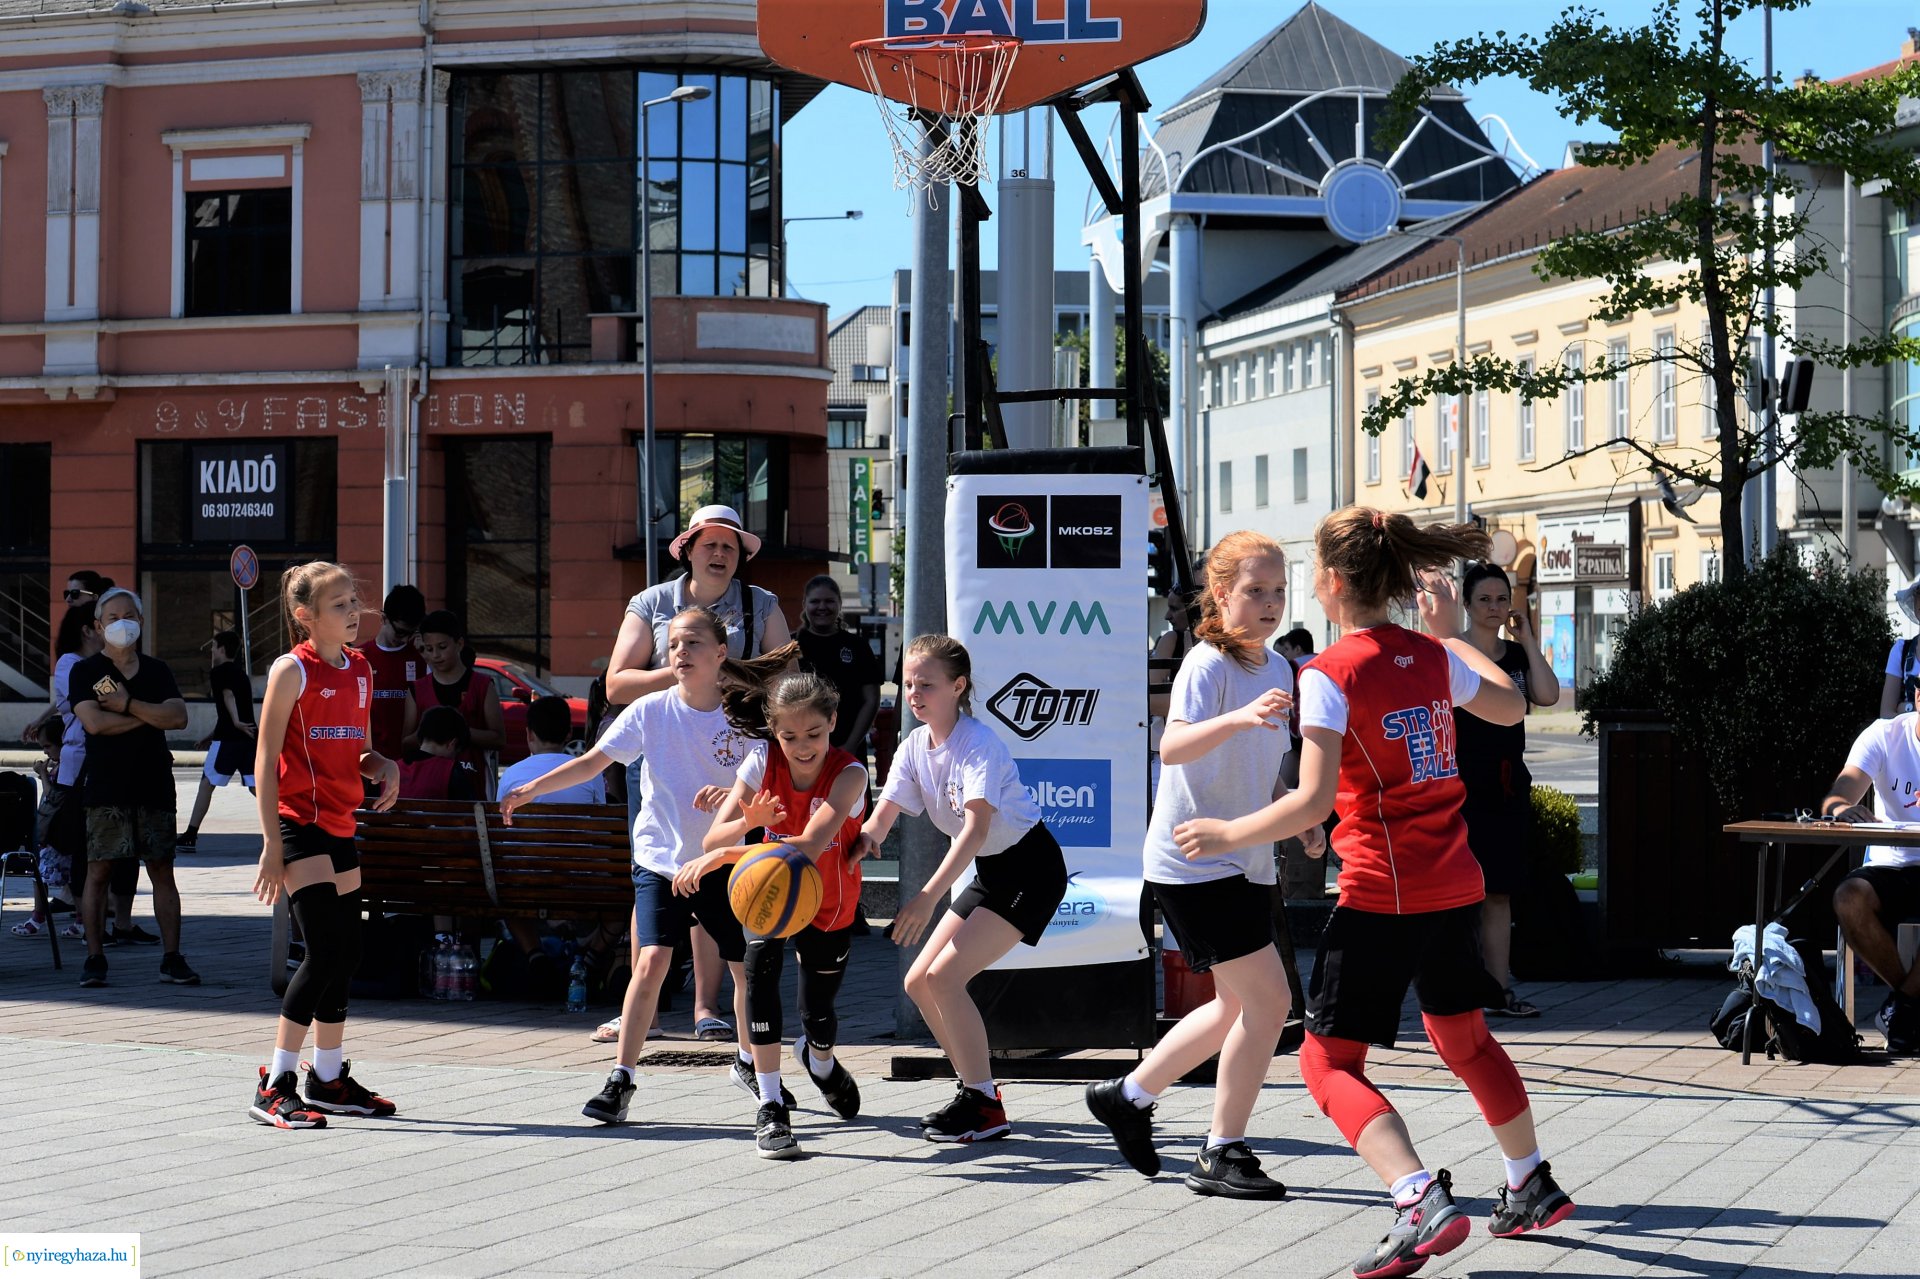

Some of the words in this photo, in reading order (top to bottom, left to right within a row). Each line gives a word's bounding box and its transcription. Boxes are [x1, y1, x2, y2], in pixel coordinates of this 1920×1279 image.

[884, 0, 1123, 49] BALL
[1011, 169, 1026, 178] 36
[264, 393, 526, 430] FASION
[200, 454, 276, 494] KIADÓ
[202, 504, 215, 518] 06
[231, 503, 274, 517] 7246340
[853, 463, 868, 567] PALEO
[1058, 526, 1113, 536] MKOSZ
[1587, 558, 1621, 575] PATIKA
[973, 600, 1111, 635] MVM
[1010, 688, 1100, 726] TOTI
[1411, 752, 1459, 784] BALL
[1058, 815, 1096, 828] game
